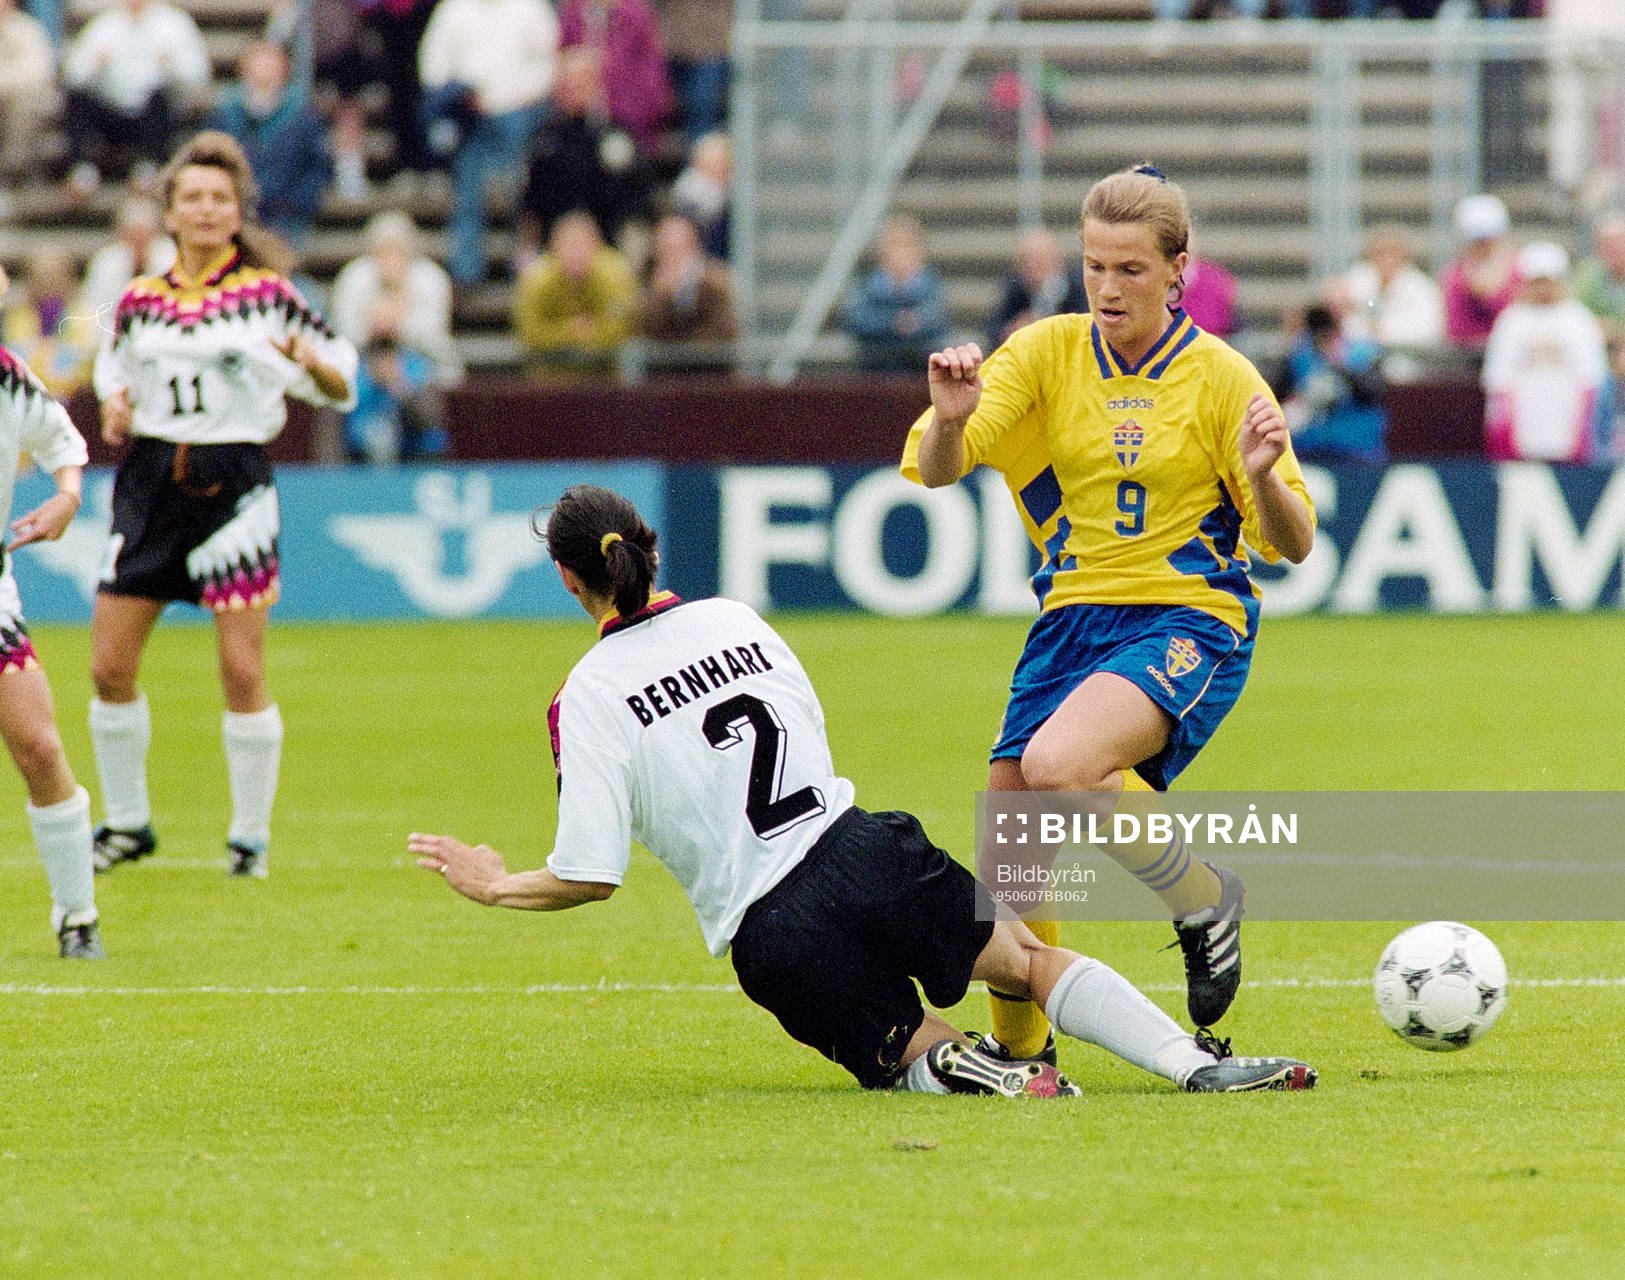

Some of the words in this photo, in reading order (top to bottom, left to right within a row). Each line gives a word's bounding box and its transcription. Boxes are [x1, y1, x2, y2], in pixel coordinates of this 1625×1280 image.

[168, 376, 204, 415] 11
[1106, 397, 1154, 409] adidas
[1115, 480, 1147, 538] 9
[718, 464, 1625, 617] FOLSAM
[1147, 665, 1176, 698] adidas
[702, 693, 826, 841] 2
